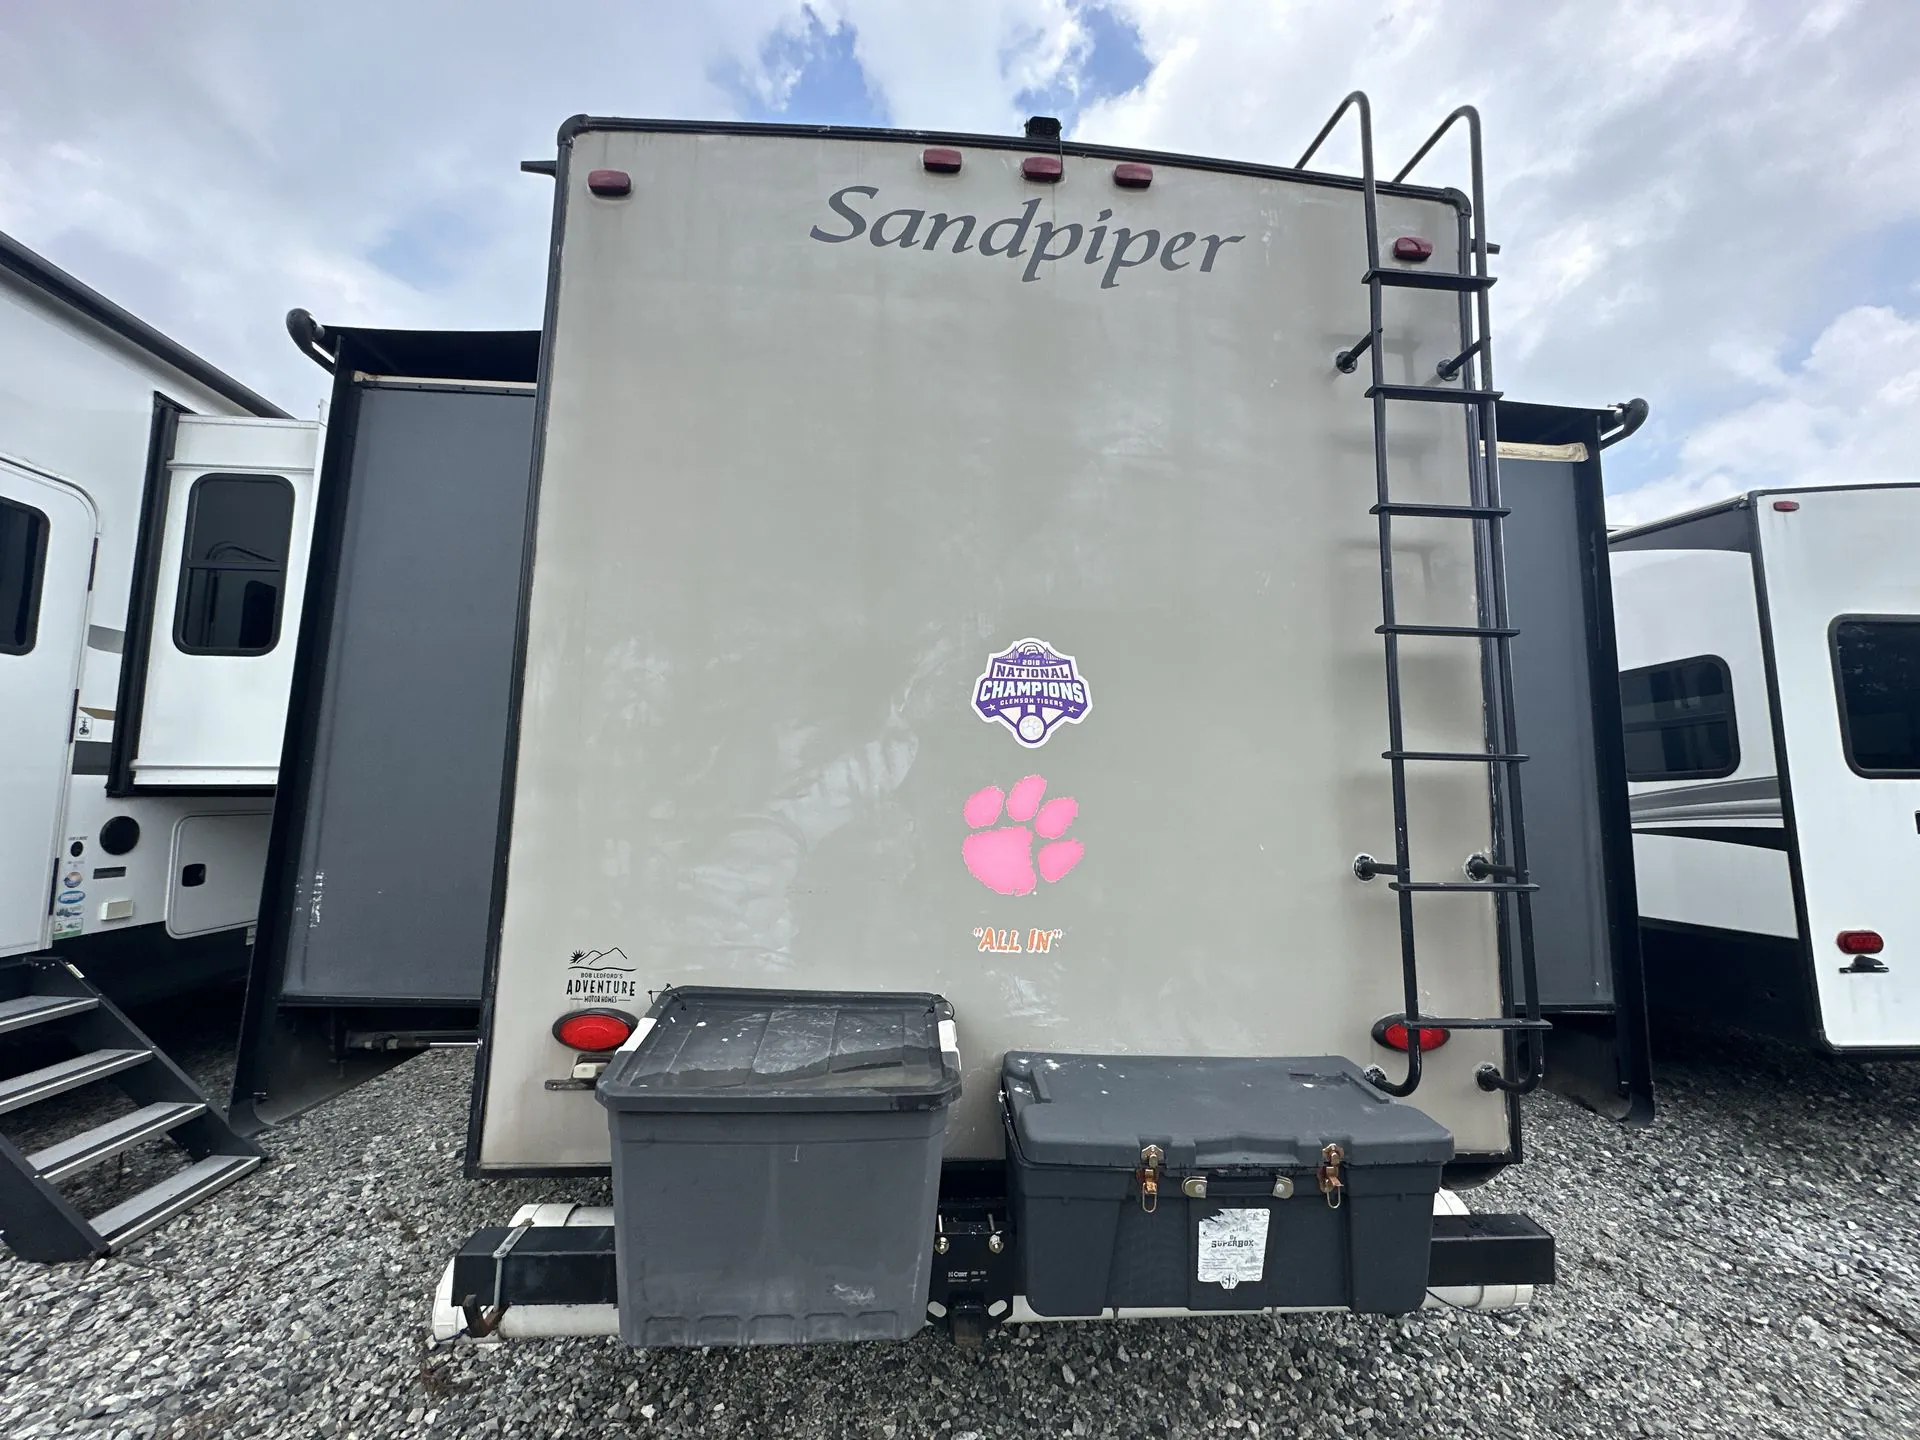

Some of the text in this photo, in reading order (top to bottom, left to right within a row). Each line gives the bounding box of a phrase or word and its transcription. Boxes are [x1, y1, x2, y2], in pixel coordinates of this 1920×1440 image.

[809, 185, 1247, 290] Sandpiper
[995, 664, 1069, 679] NATIONAL
[979, 680, 1085, 704] CHAMPIONS
[999, 697, 1064, 707] CLEMSON TIGERS
[973, 926, 1063, 953] "ALL IN"
[566, 979, 636, 997] ADVENTURE
[584, 995, 600, 1003] MOTOR
